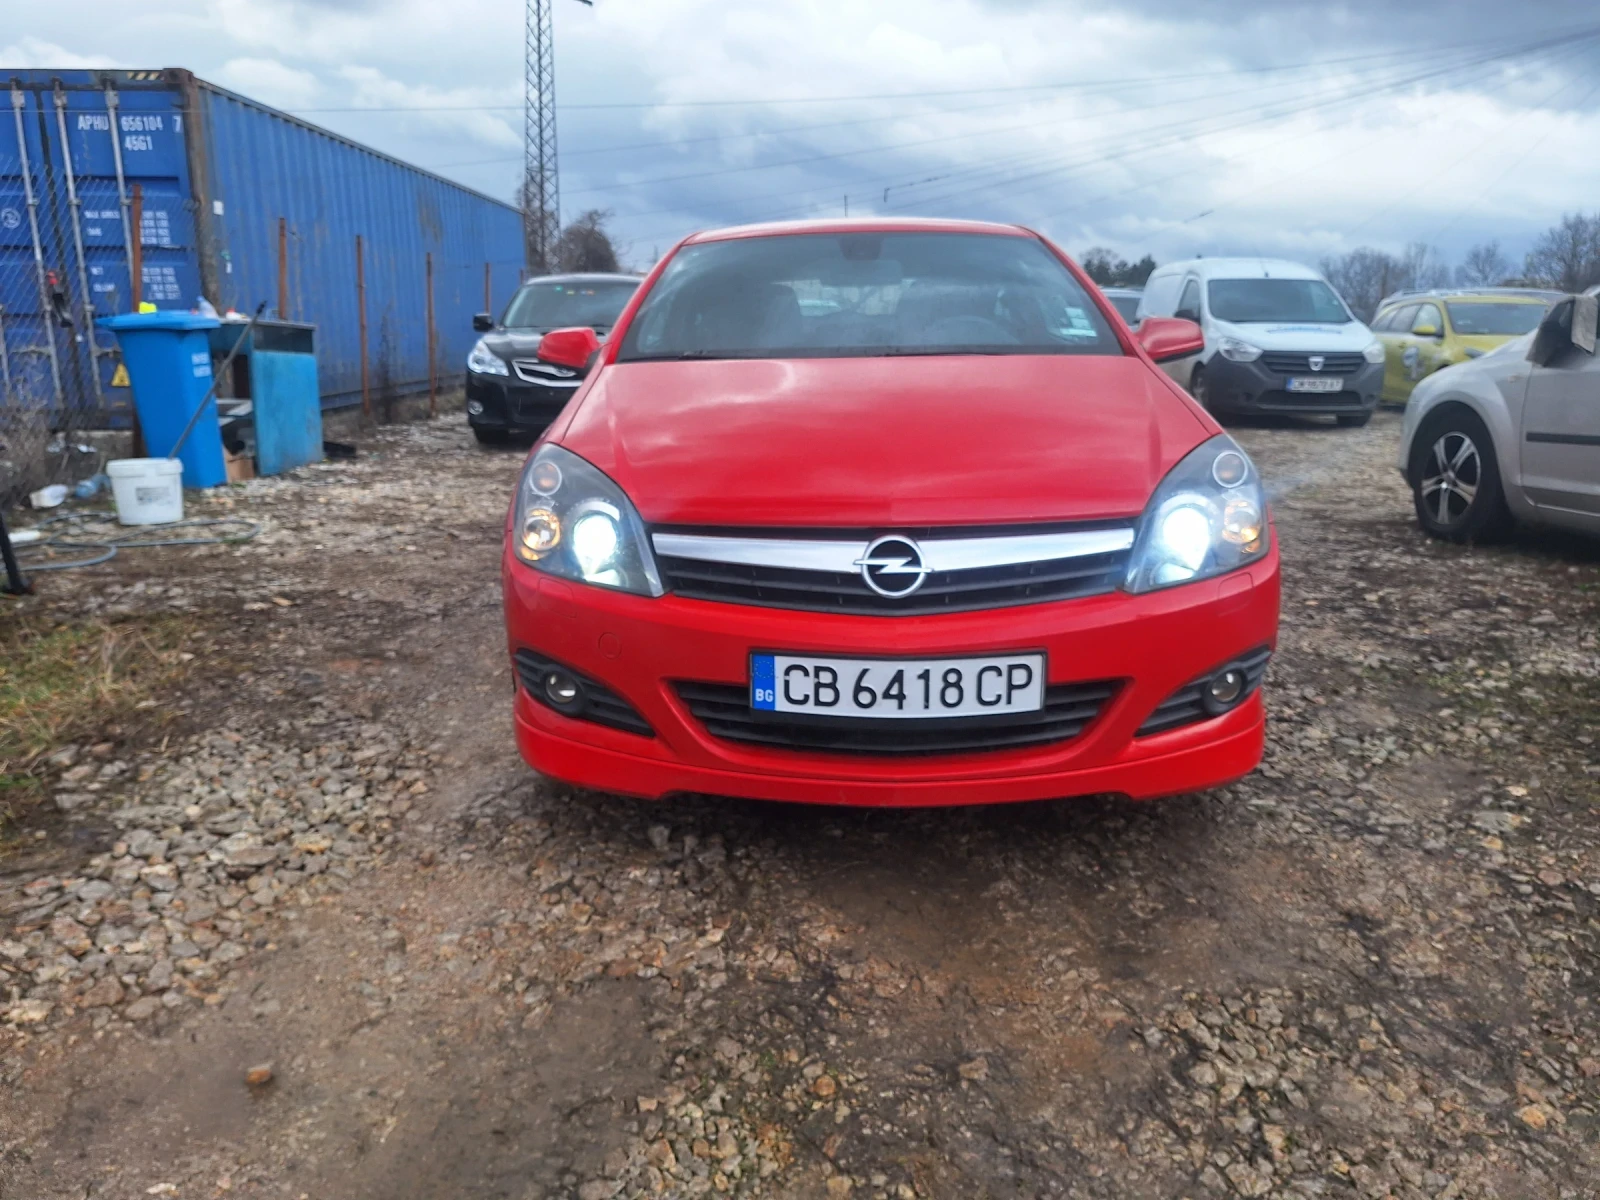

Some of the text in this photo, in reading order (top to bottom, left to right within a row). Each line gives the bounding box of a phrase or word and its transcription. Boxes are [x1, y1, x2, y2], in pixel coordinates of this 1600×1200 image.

[78, 115, 109, 130] APHU
[173, 115, 181, 132] 7
[124, 135, 153, 151] 45G1
[783, 663, 1033, 710] CB 6418 CP
[755, 688, 774, 702] BG
